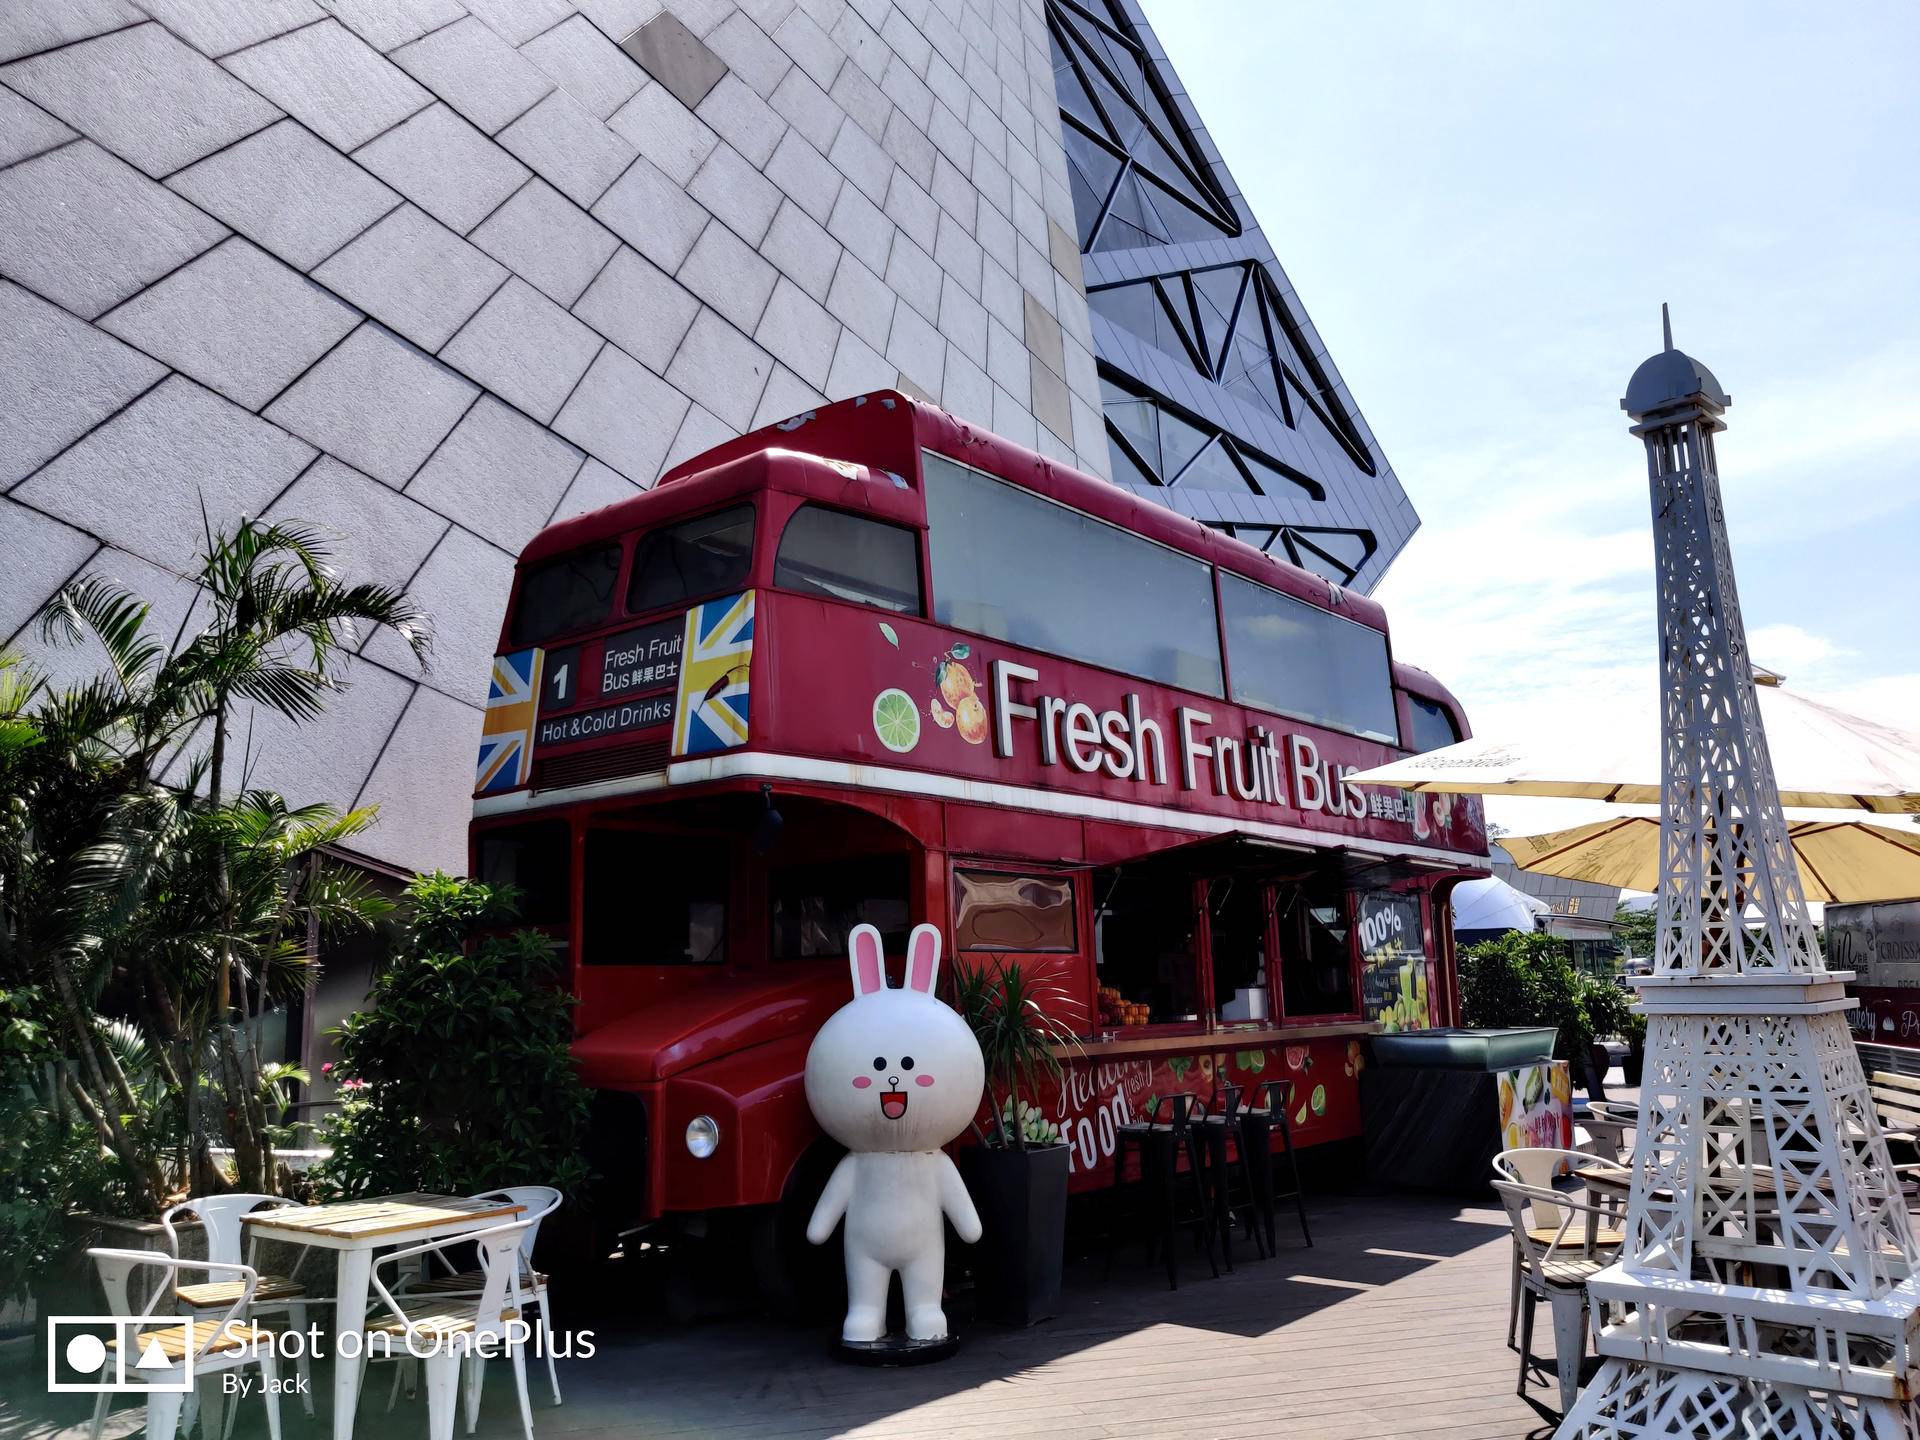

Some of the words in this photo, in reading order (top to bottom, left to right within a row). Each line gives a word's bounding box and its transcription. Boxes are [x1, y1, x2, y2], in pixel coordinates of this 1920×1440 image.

[605, 646, 645, 671] Fresh
[649, 634, 683, 660] Fruit
[553, 664, 568, 700] 1
[602, 672, 630, 693] Bus
[631, 661, 679, 685] 鲜果巴士
[542, 720, 567, 743] Hot
[620, 701, 672, 727] Drinks
[991, 658, 1168, 785] Fresh
[1177, 705, 1286, 806] Fruit
[1287, 733, 1368, 820] Bus
[1358, 902, 1402, 952] 100%
[1846, 1005, 1876, 1041] akery
